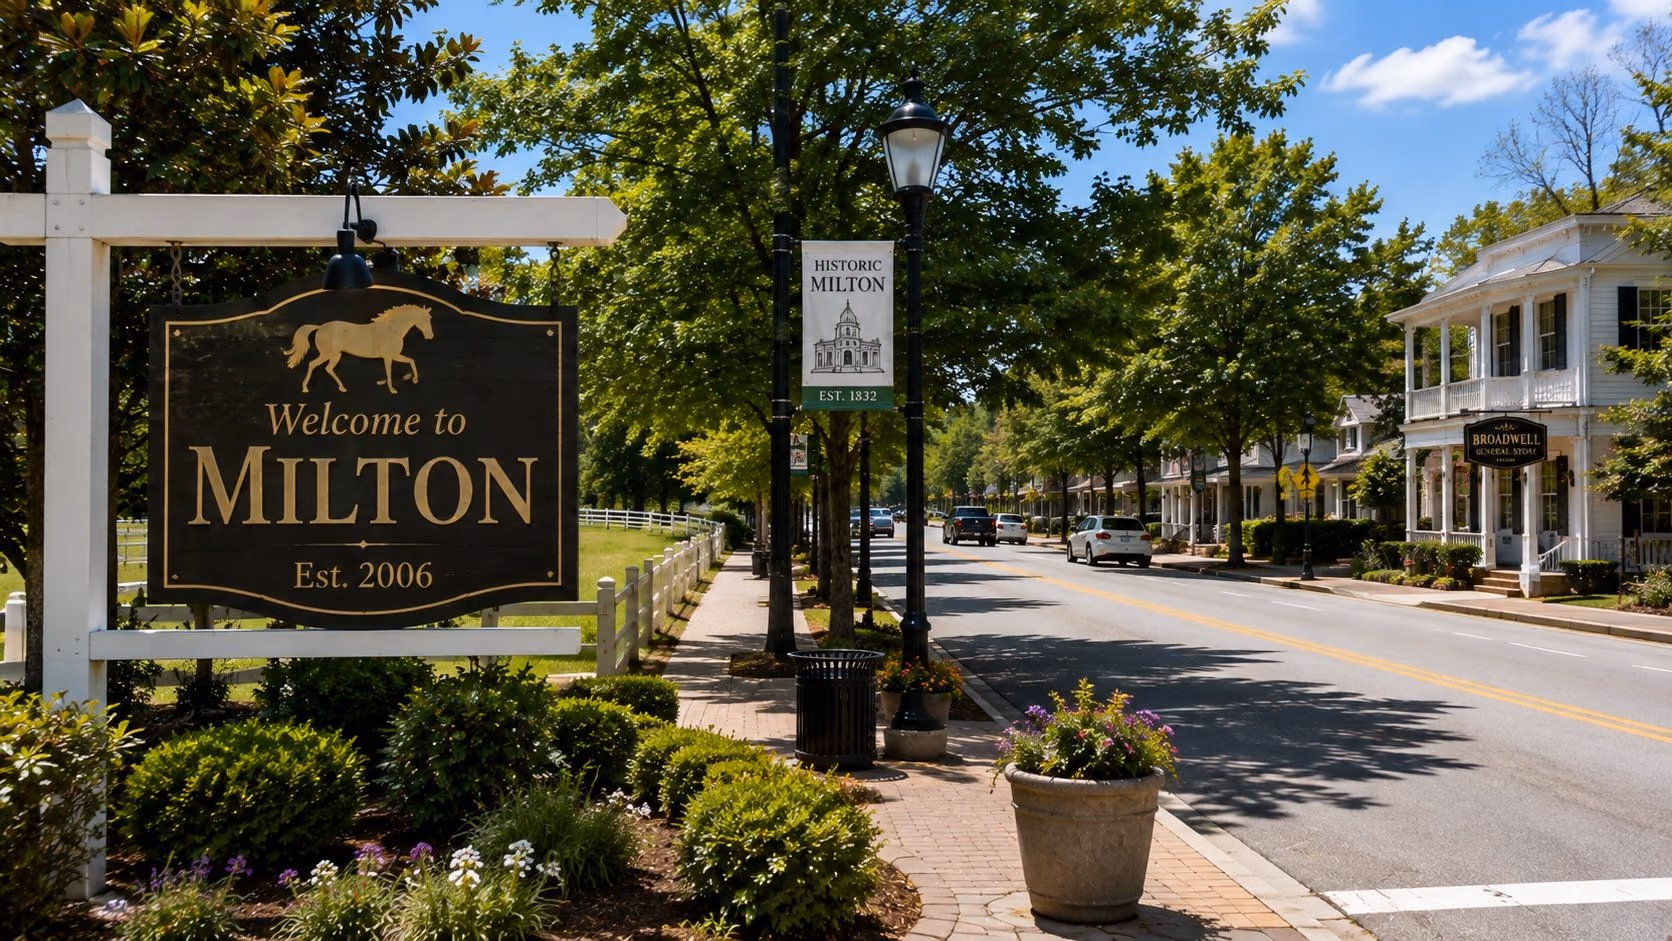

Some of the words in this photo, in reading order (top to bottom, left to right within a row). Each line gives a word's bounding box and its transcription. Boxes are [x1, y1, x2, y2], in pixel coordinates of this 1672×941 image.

[815, 259, 882, 272] HISTORIC
[810, 275, 886, 293] MILTON
[819, 390, 845, 402] EST.
[850, 390, 878, 402] 1832
[265, 402, 420, 436] Welcome
[435, 408, 466, 436] to
[1473, 433, 1541, 445] BROADWELL
[188, 446, 538, 525] MILTON
[293, 562, 348, 589] Est.
[359, 561, 433, 589] 2006
